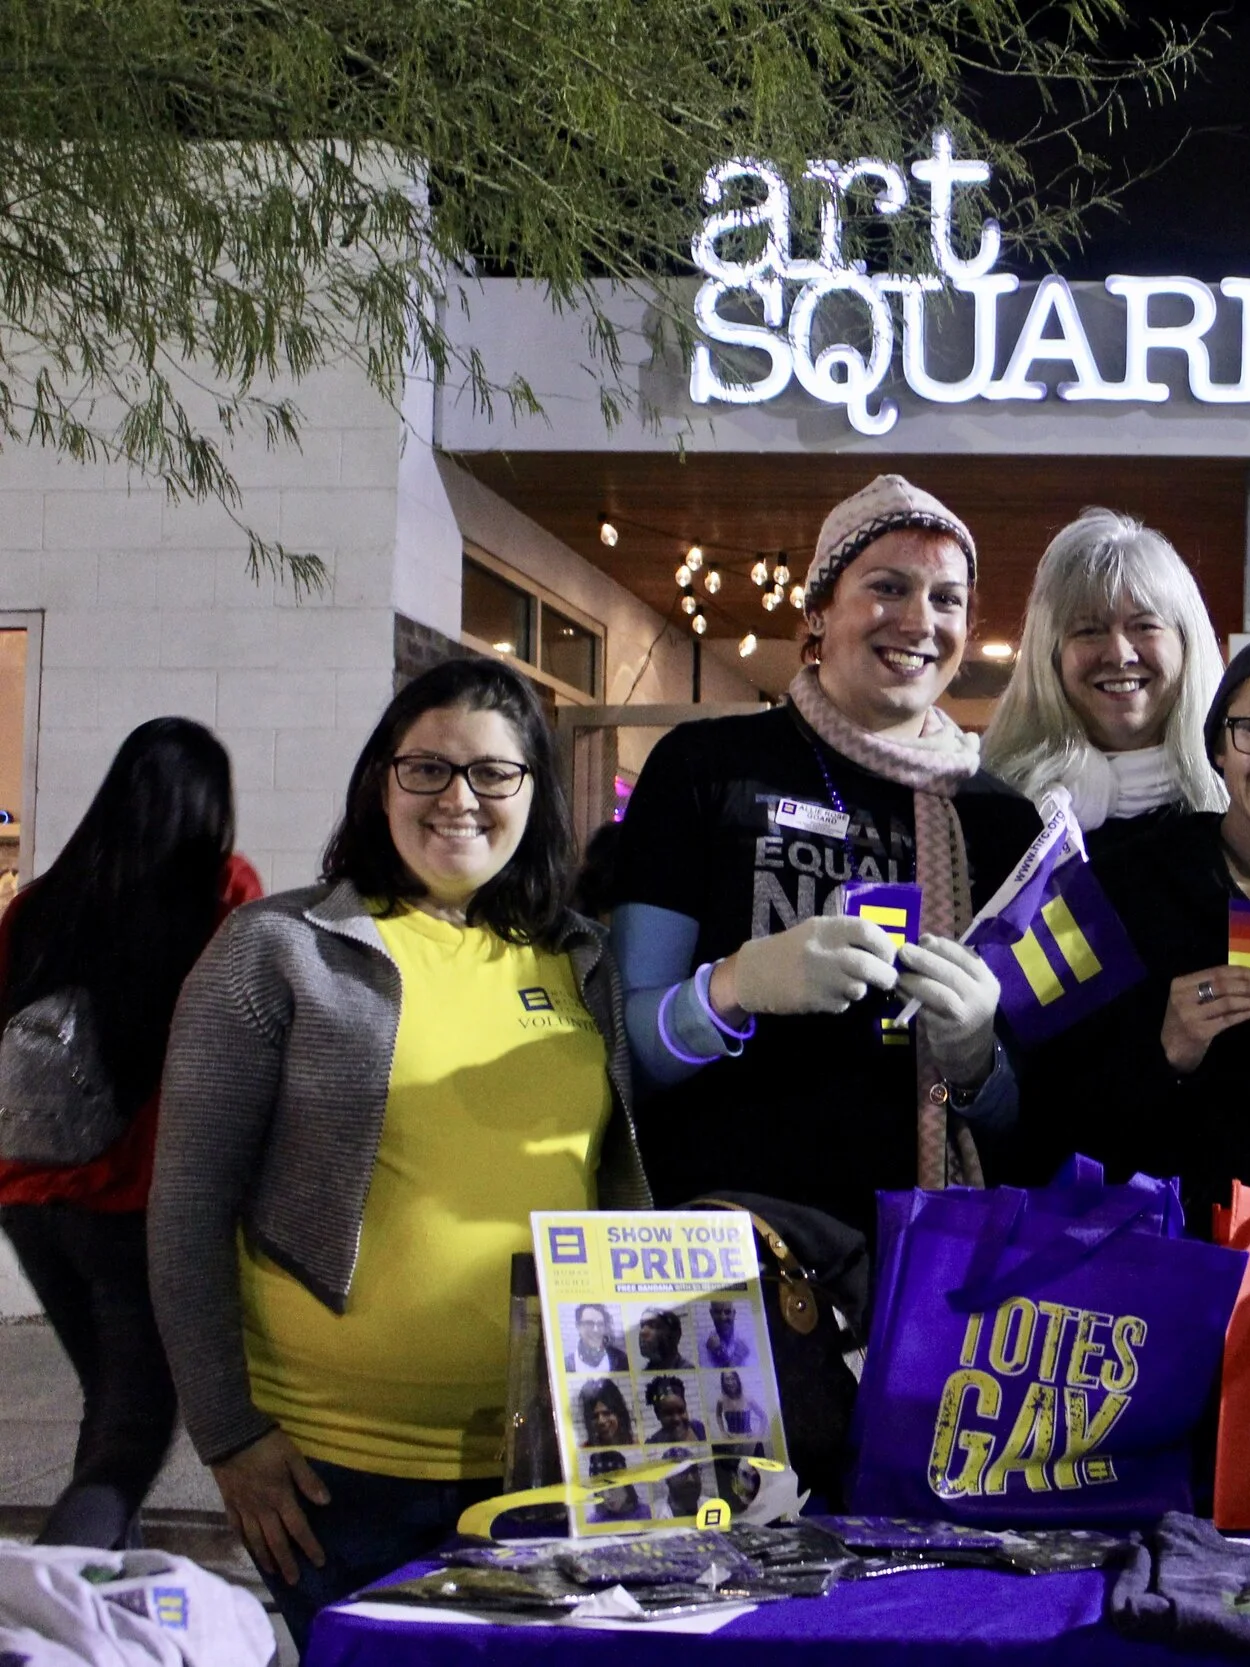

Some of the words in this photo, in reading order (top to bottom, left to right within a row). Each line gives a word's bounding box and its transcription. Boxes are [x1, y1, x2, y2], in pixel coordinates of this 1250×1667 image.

[692, 129, 1001, 280] art
[754, 836, 898, 883] EQUAL
[1014, 810, 1066, 882] www.hrc.org
[607, 1226, 673, 1243] SHOW
[682, 1226, 740, 1243] YOUR
[610, 1247, 747, 1280] PRIDE
[960, 1296, 1148, 1393] TOTES
[928, 1368, 1132, 1499] GAY
